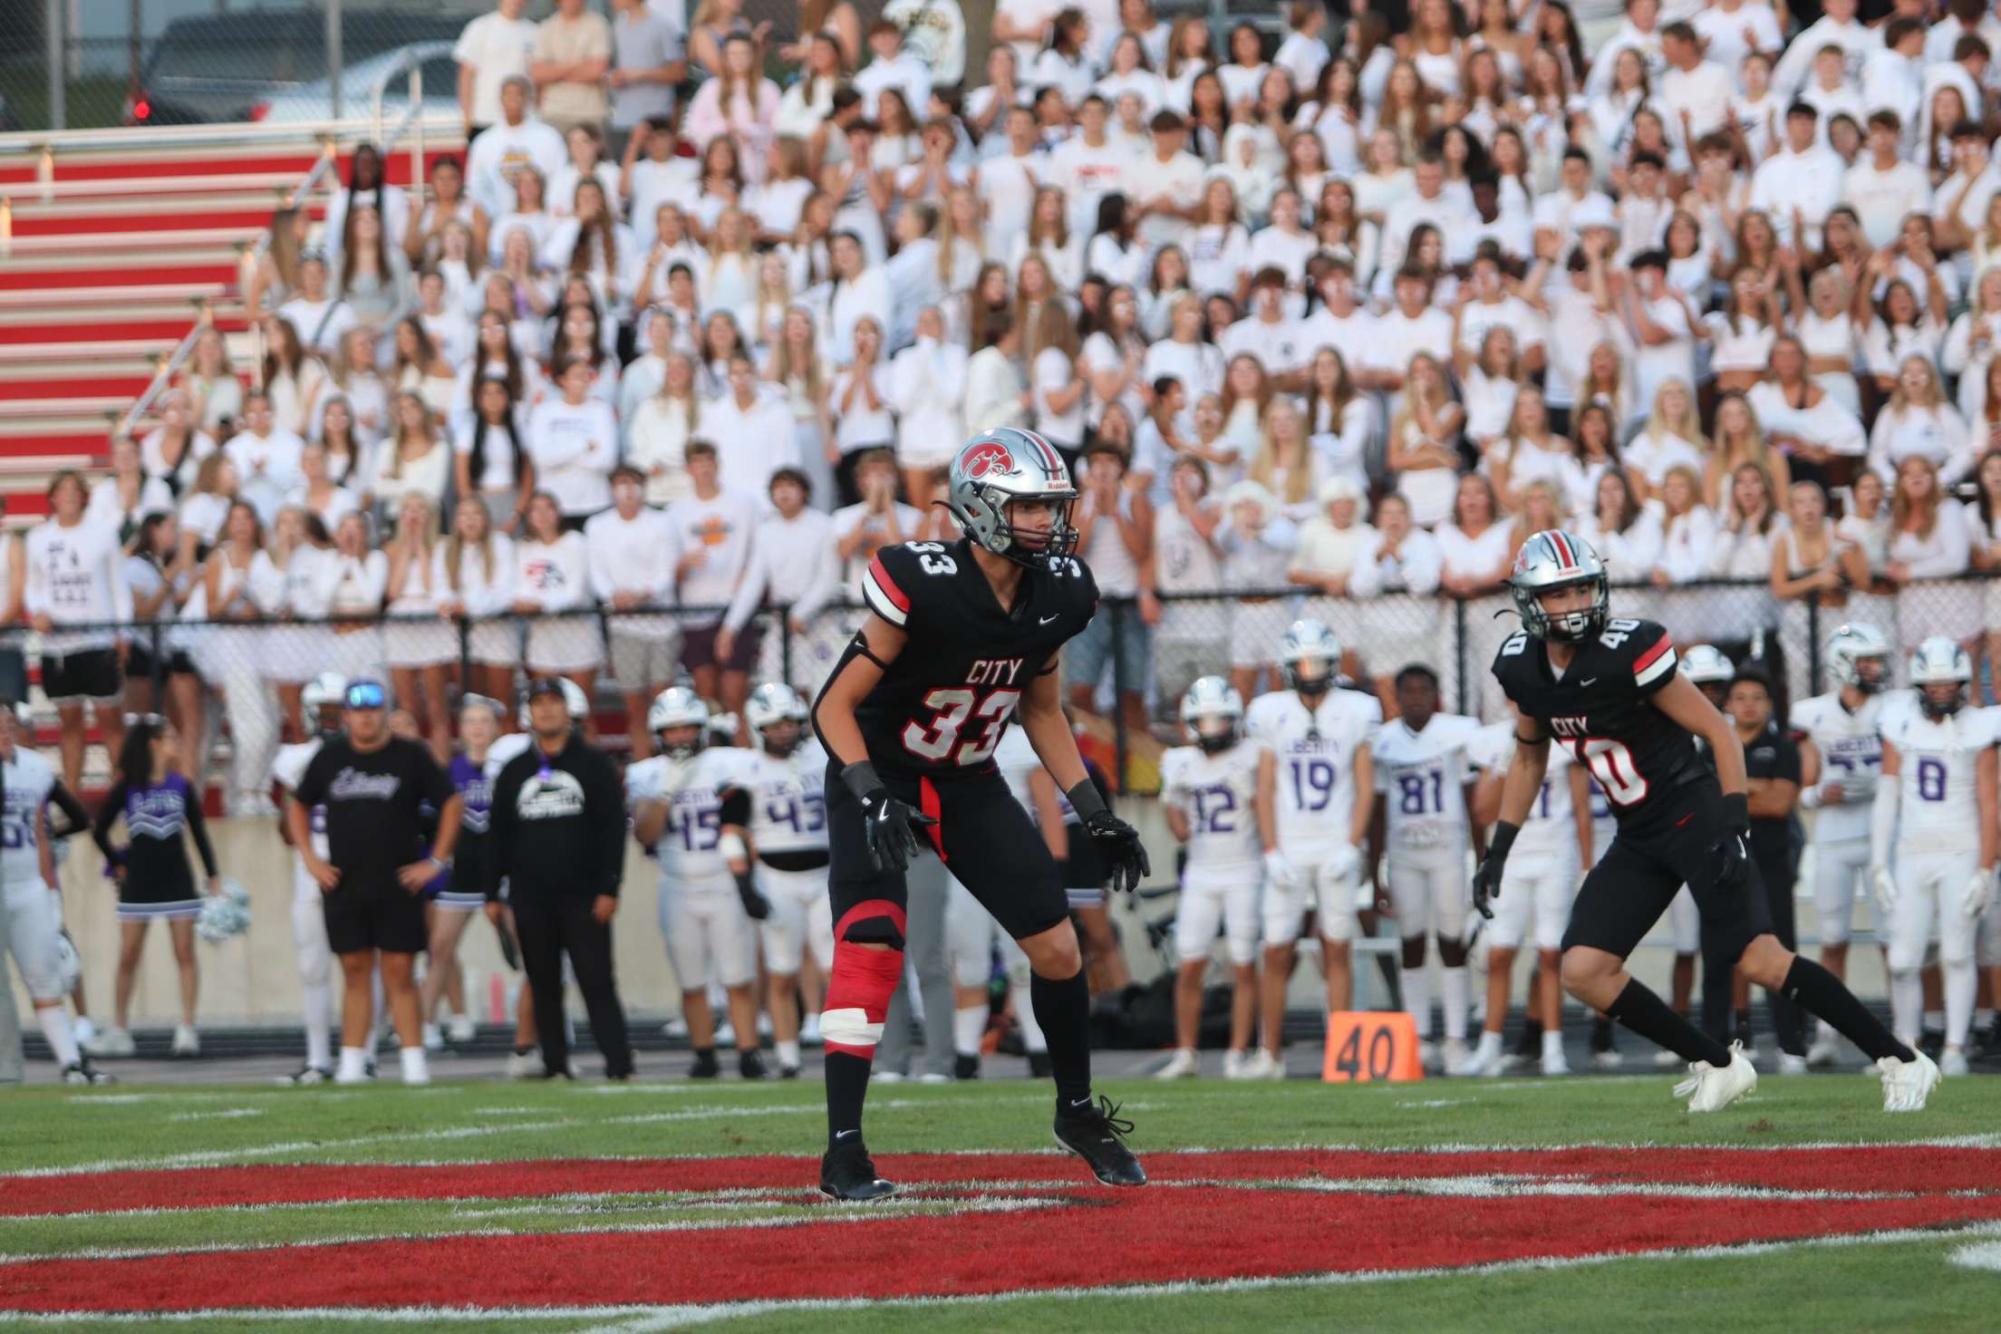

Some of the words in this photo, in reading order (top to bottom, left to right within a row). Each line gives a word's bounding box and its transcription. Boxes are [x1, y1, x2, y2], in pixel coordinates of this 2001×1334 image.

[1599, 619, 1640, 650] 40
[965, 658, 1024, 685] CITY
[902, 686, 1021, 769] 33
[1550, 716, 1589, 735] CITY
[1289, 760, 1335, 811] 19
[1399, 768, 1443, 815] 81
[1558, 736, 1649, 807] 0
[1917, 756, 1946, 801] 8
[766, 793, 826, 832] 43
[1194, 784, 1237, 833] 12
[1335, 1024, 1394, 1080] 40
